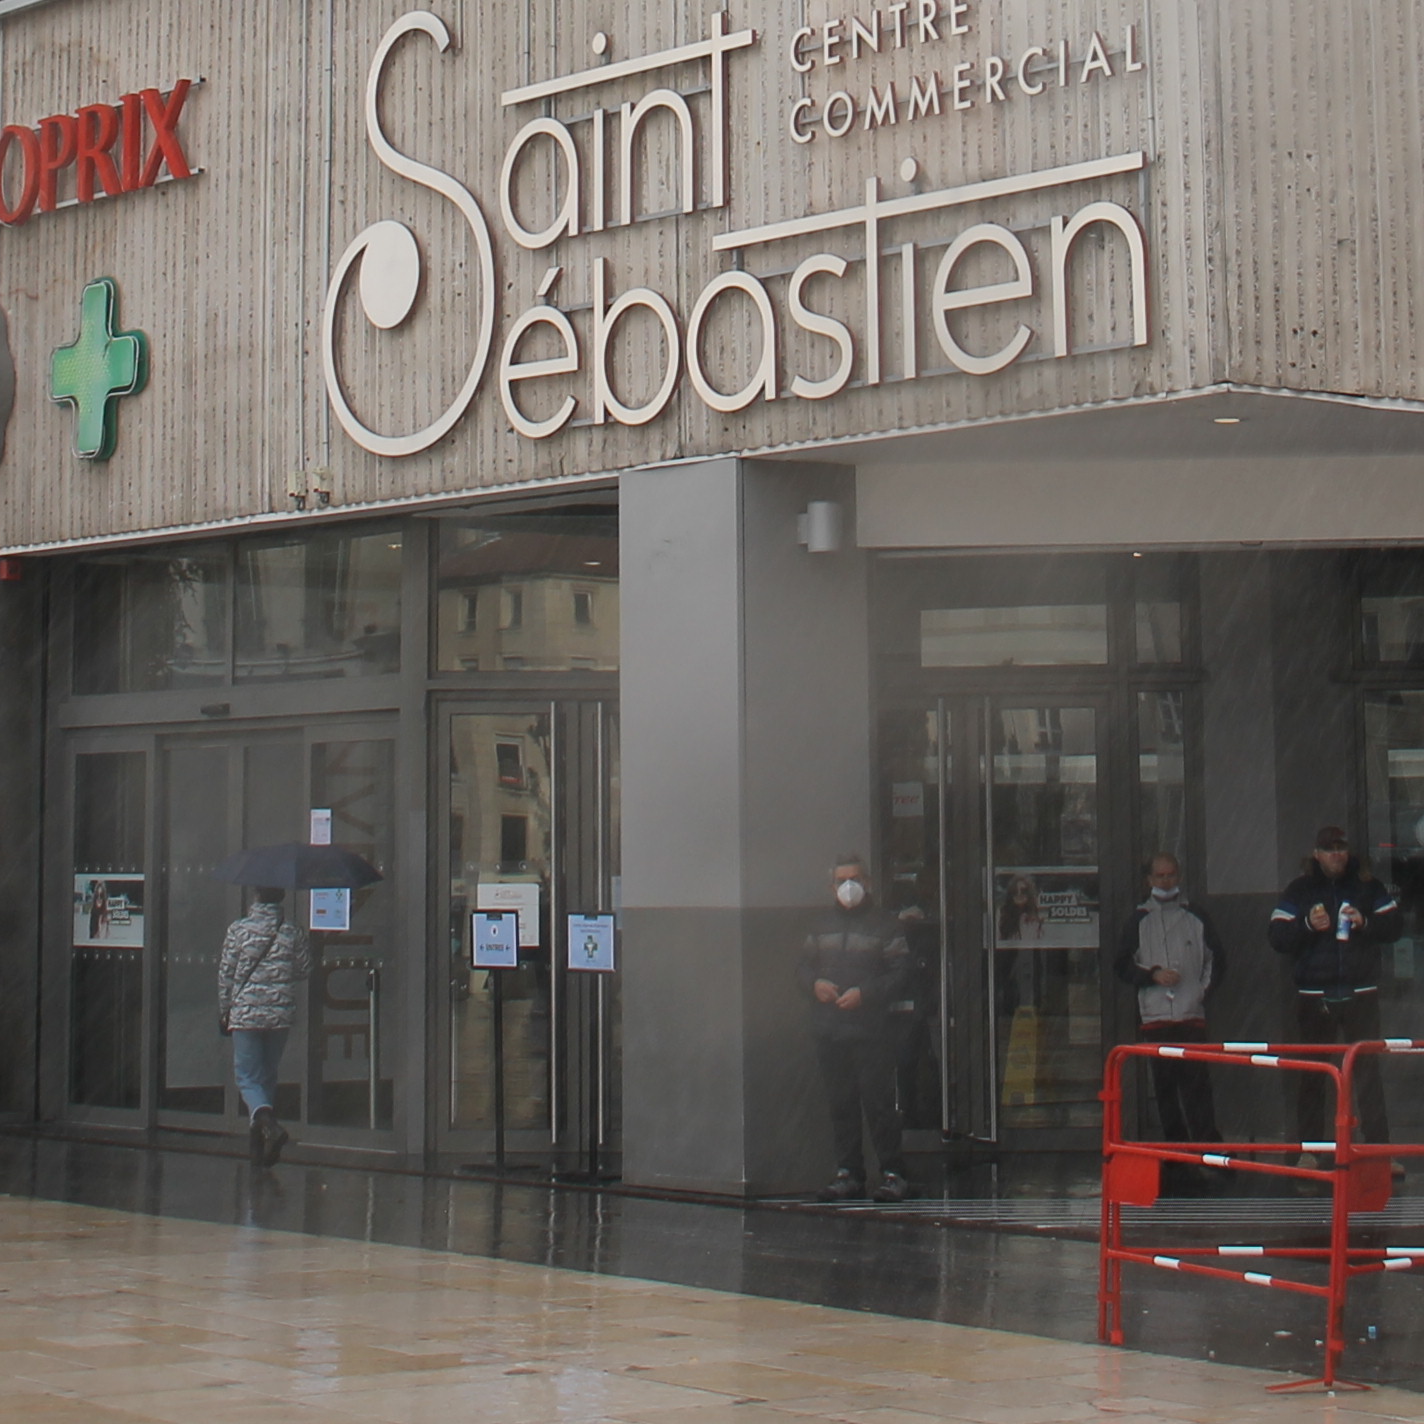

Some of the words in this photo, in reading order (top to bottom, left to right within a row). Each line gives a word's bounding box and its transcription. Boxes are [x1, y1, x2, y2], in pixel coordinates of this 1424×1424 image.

[789, 24, 1146, 145] COMMERCIAL
[1040, 894, 1073, 904] HAPPY
[1051, 906, 1087, 917] SOLDES
